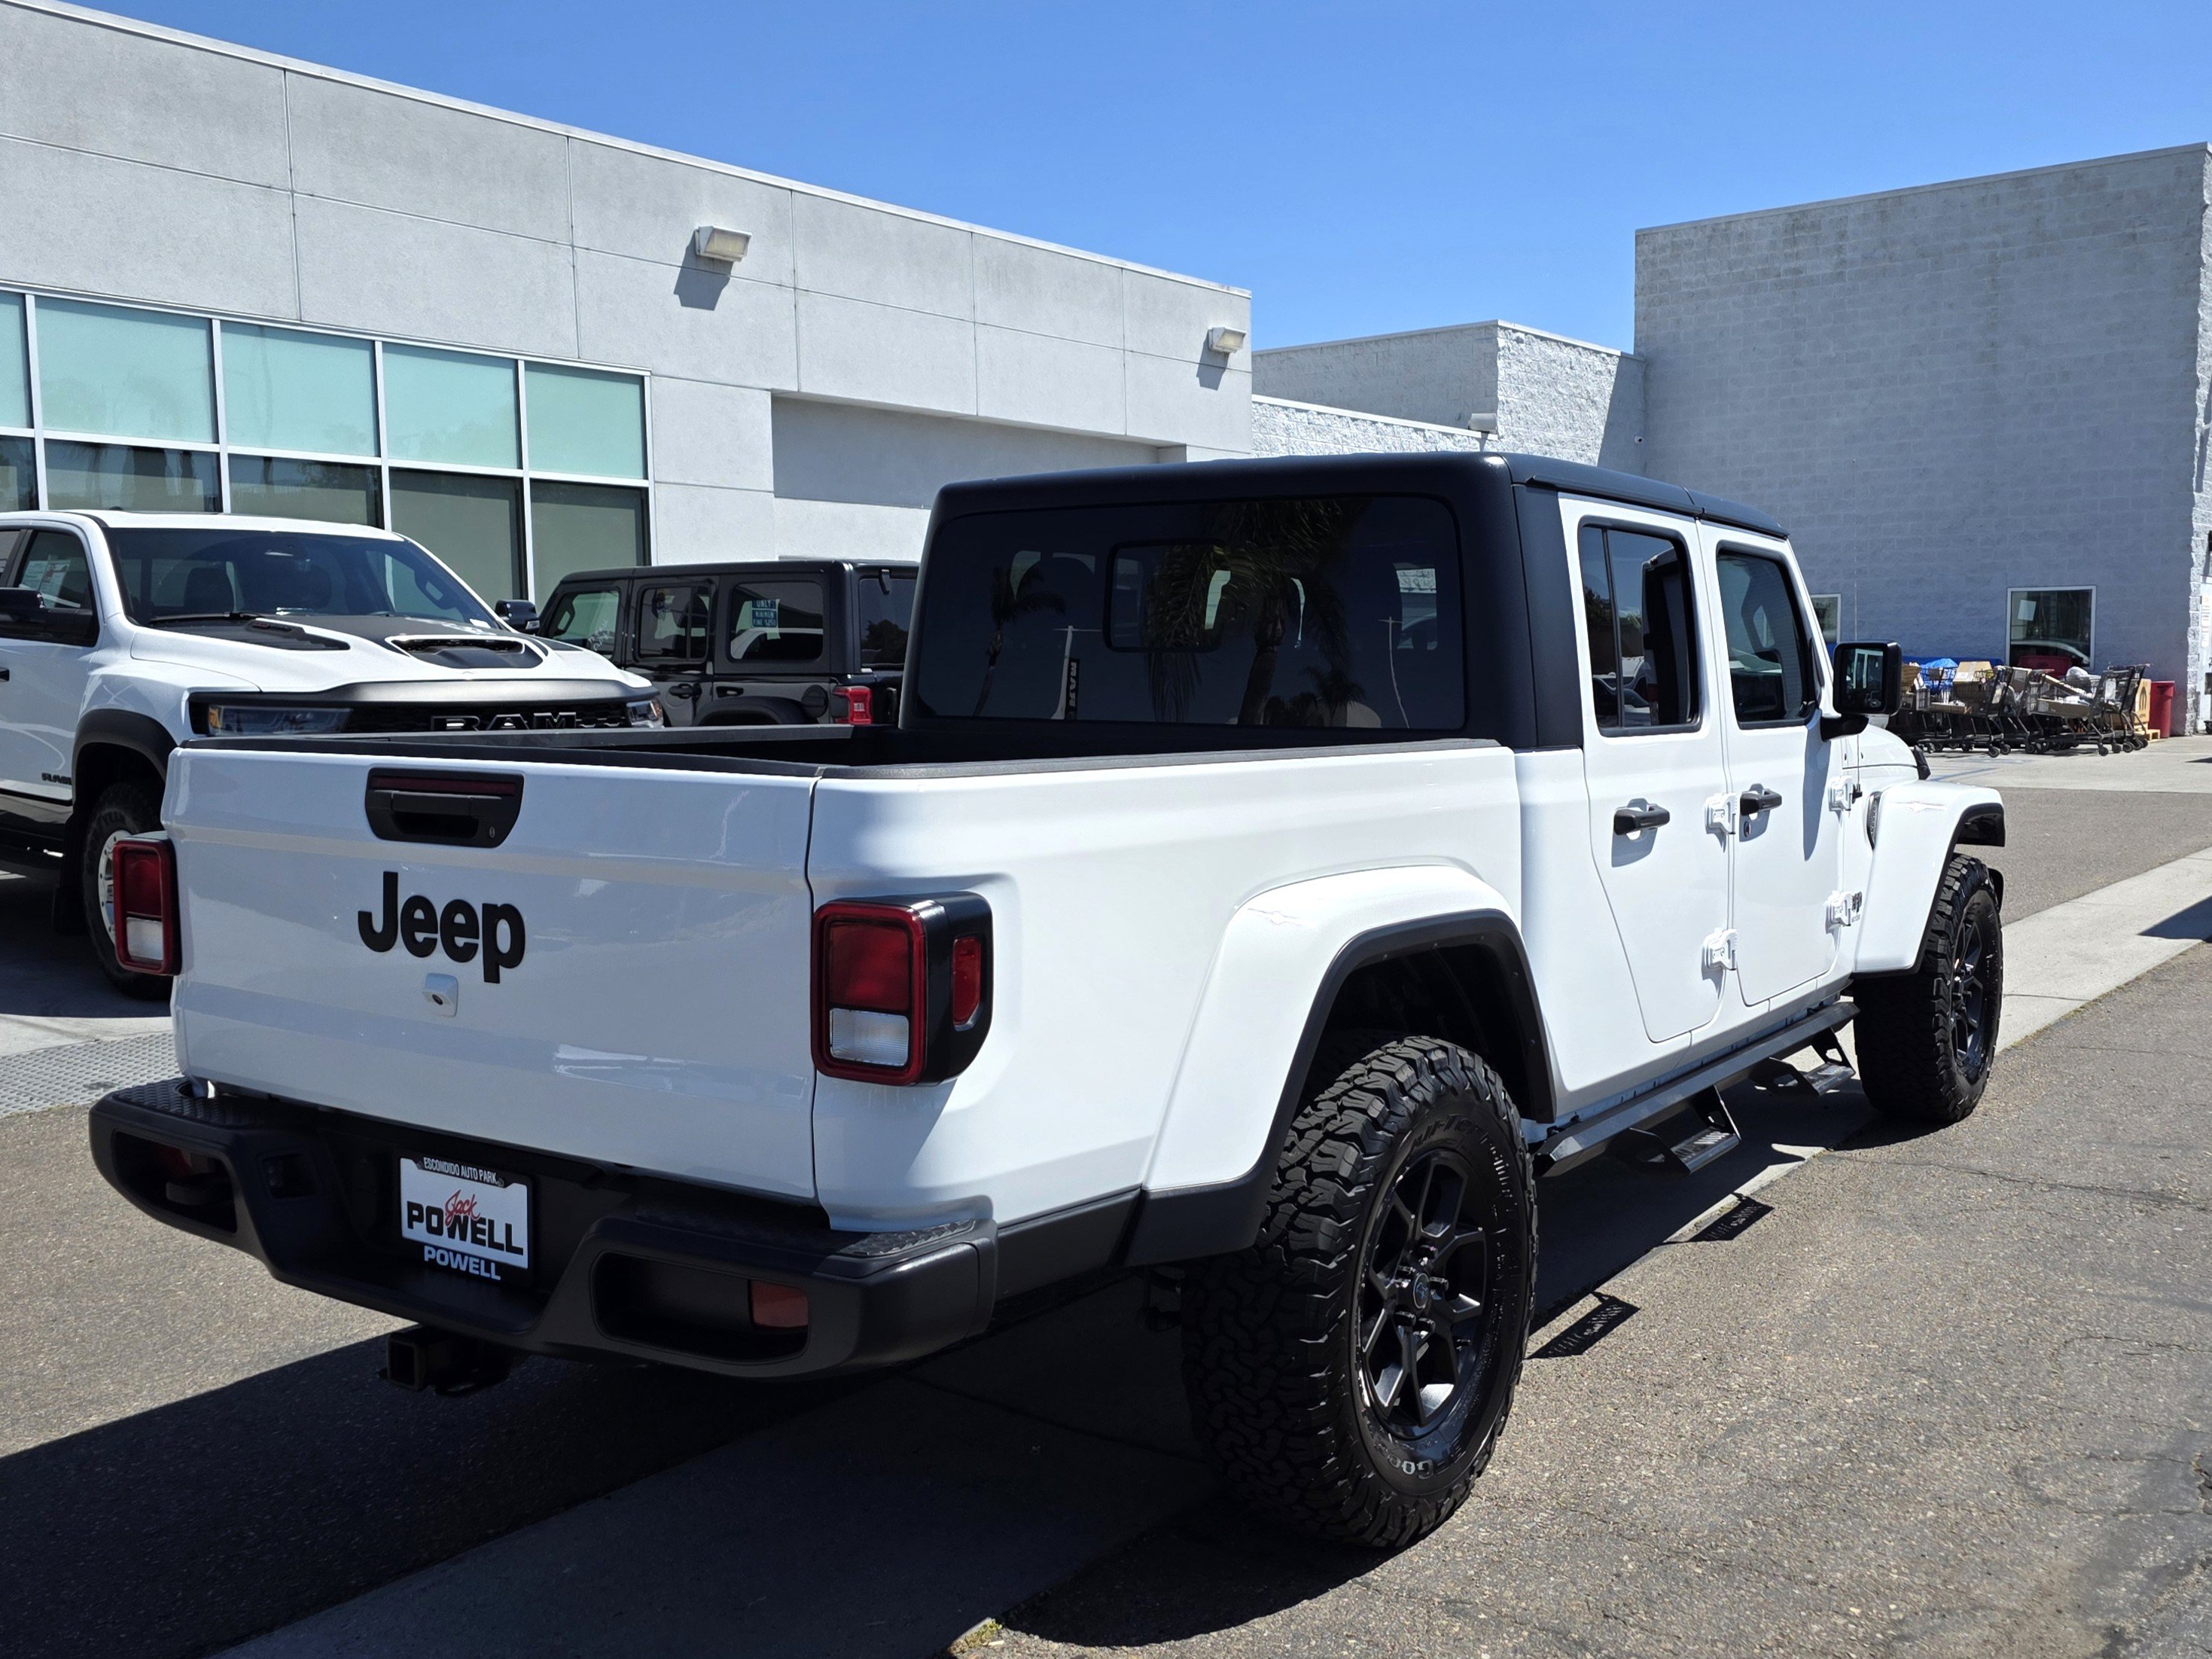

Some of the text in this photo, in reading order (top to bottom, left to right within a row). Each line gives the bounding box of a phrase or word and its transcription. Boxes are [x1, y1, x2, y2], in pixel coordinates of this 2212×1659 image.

[431, 712, 577, 731] RAM
[358, 871, 526, 984] Jeep
[423, 1157, 498, 1185] ESCONDIDO AUTO PARK
[444, 1189, 480, 1227] Jack
[407, 1200, 523, 1255] POWELL
[424, 1245, 501, 1280] POWELL
